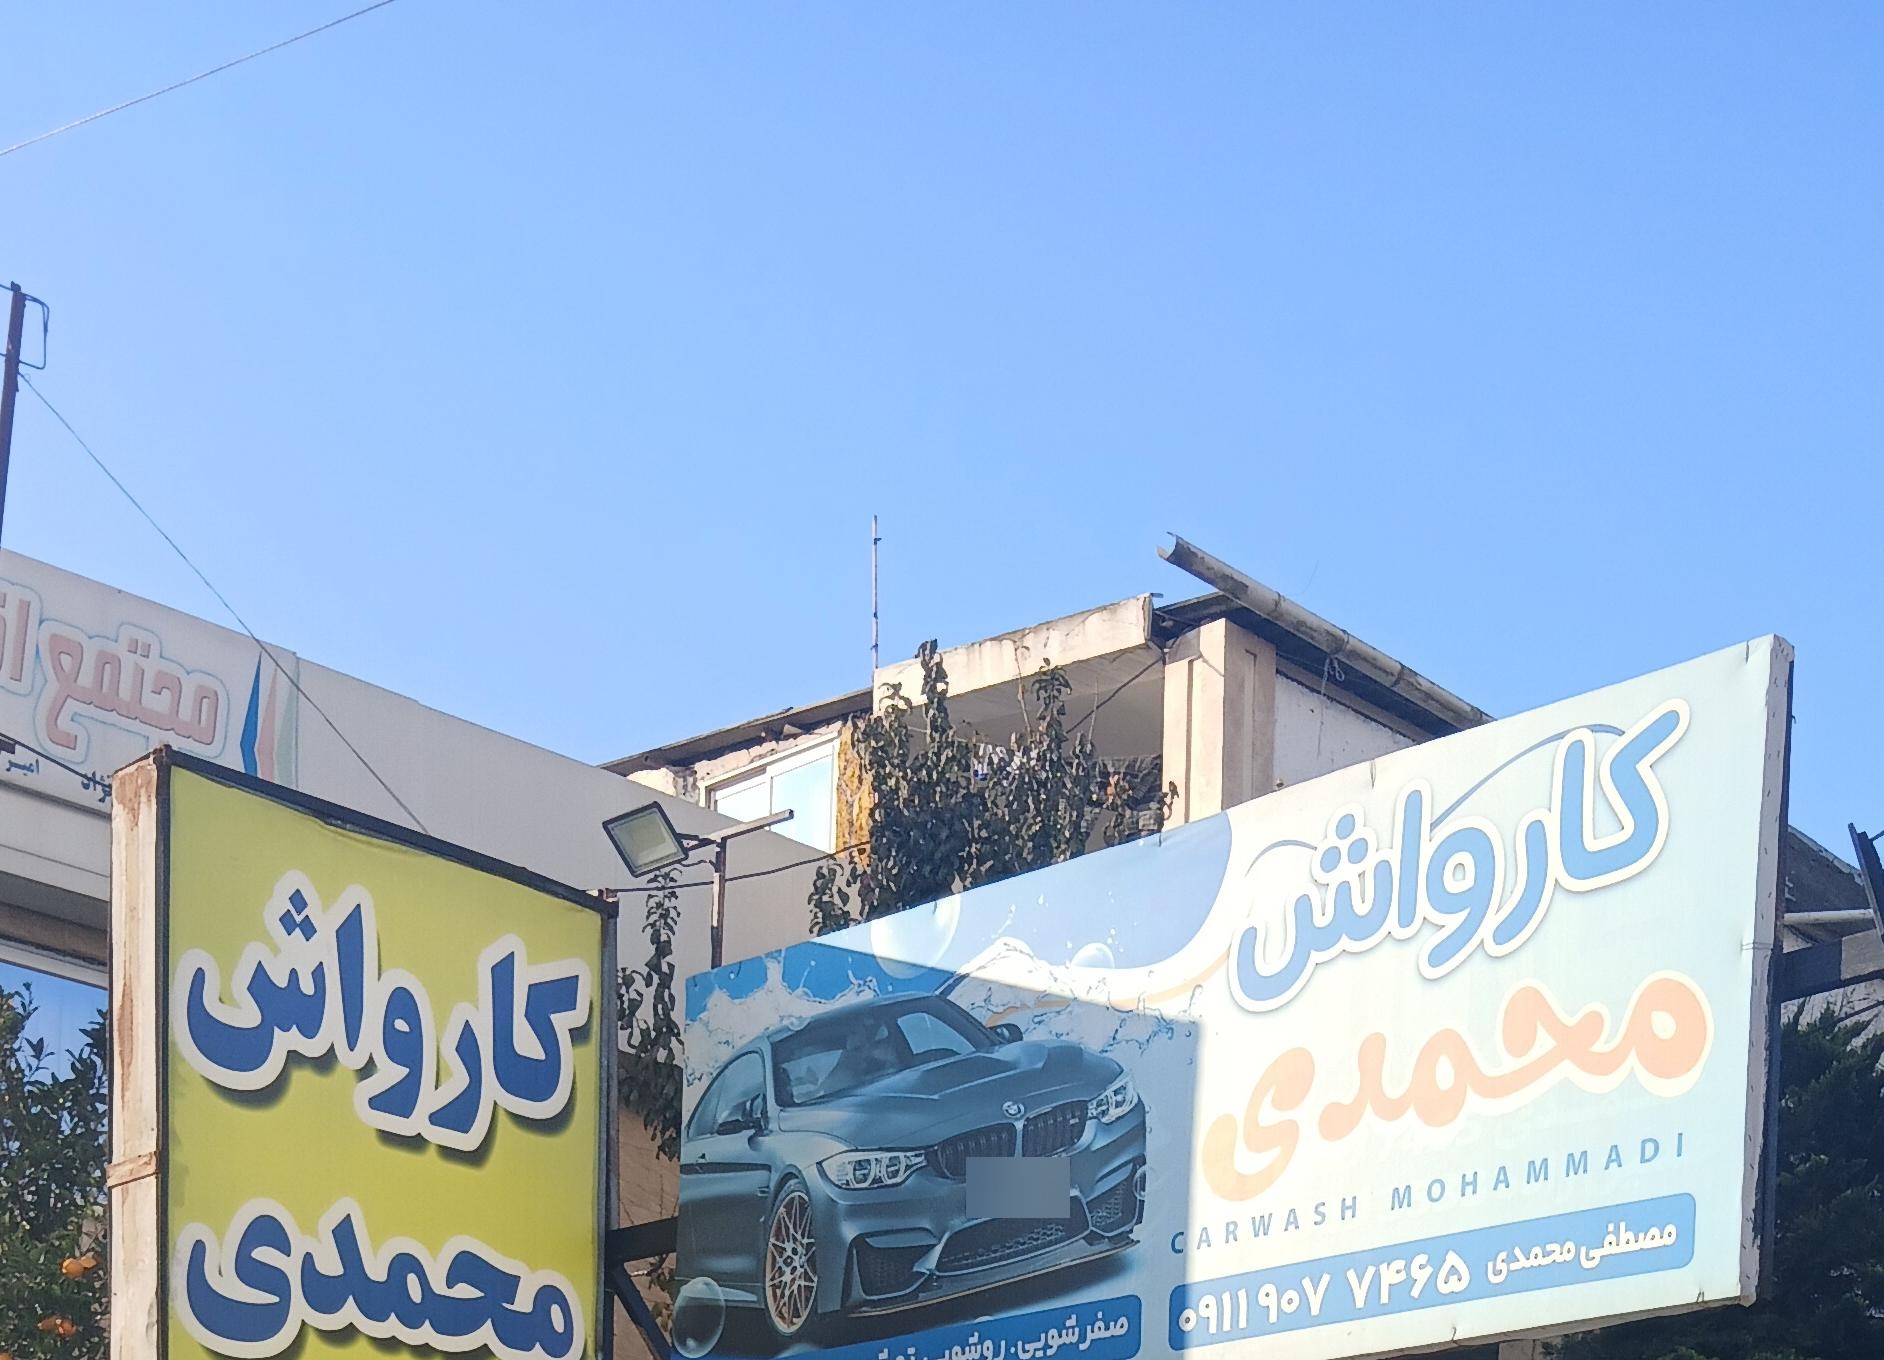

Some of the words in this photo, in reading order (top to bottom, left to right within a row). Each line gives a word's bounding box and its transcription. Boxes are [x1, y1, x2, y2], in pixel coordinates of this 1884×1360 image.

[45, 632, 219, 752] مجتمع
[1231, 704, 1686, 1006] کارواش
[184, 886, 581, 1136] کارواش
[1202, 975, 1709, 1202] محمدی
[1170, 1195, 1358, 1255] CARWASH
[1389, 1131, 1685, 1211] MOHAMMADI
[1579, 1220, 1678, 1270] مصطفی
[184, 1211, 578, 1360] محمدی
[1486, 1244, 1575, 1285] محمدی
